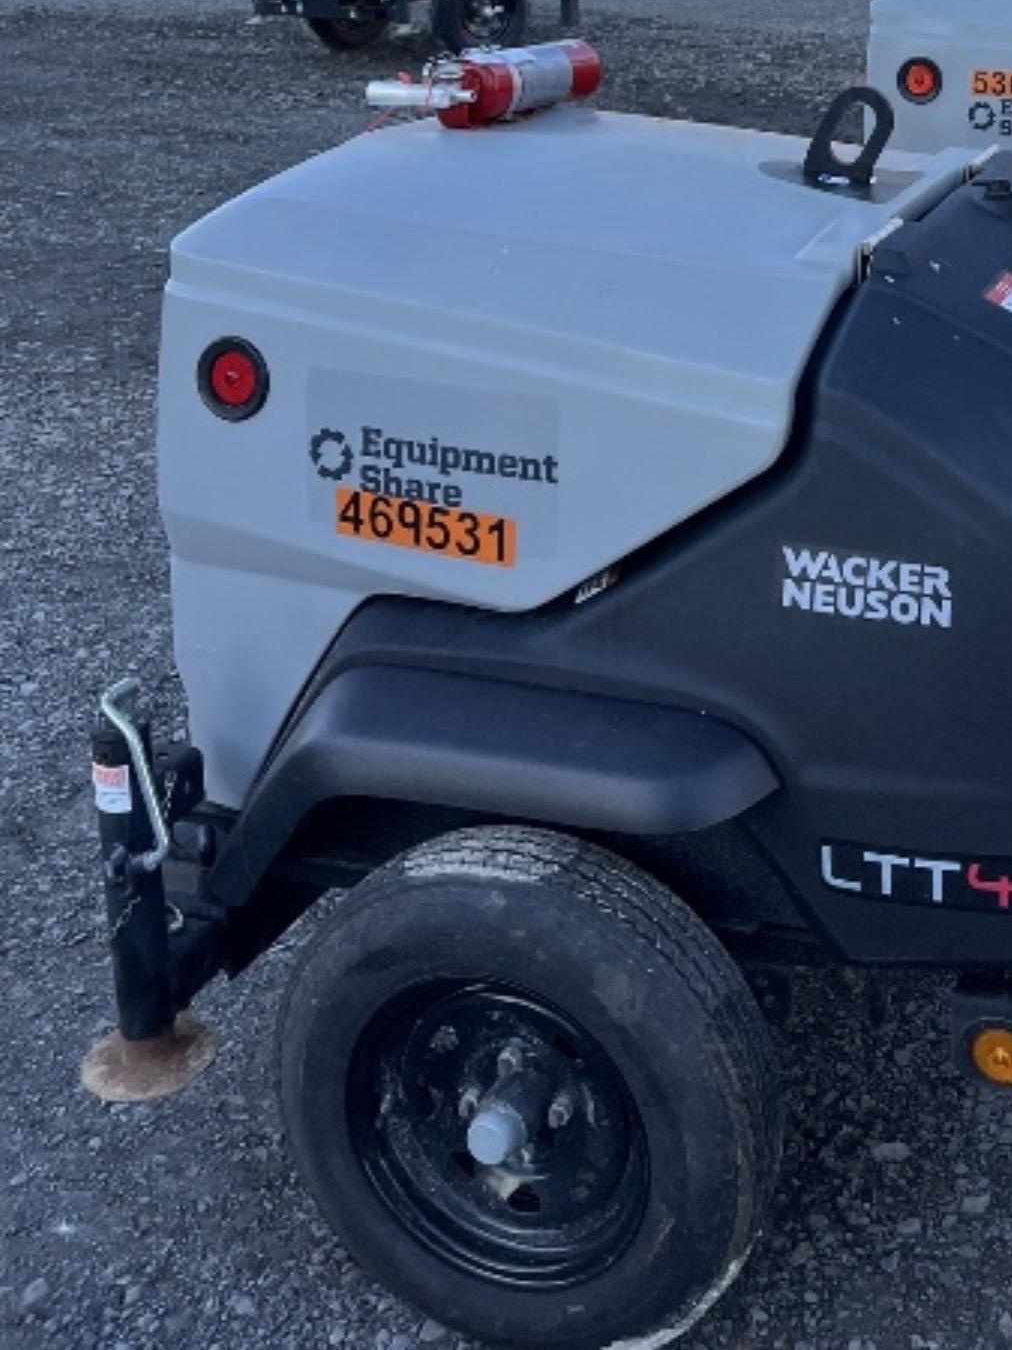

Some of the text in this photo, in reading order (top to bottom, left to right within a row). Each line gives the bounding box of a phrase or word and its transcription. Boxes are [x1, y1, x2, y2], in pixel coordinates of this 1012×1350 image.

[360, 426, 558, 483] Equipment
[359, 465, 463, 507] Share
[338, 491, 506, 562] 469531
[782, 545, 953, 598] WACKER
[782, 578, 953, 629] NEUSON
